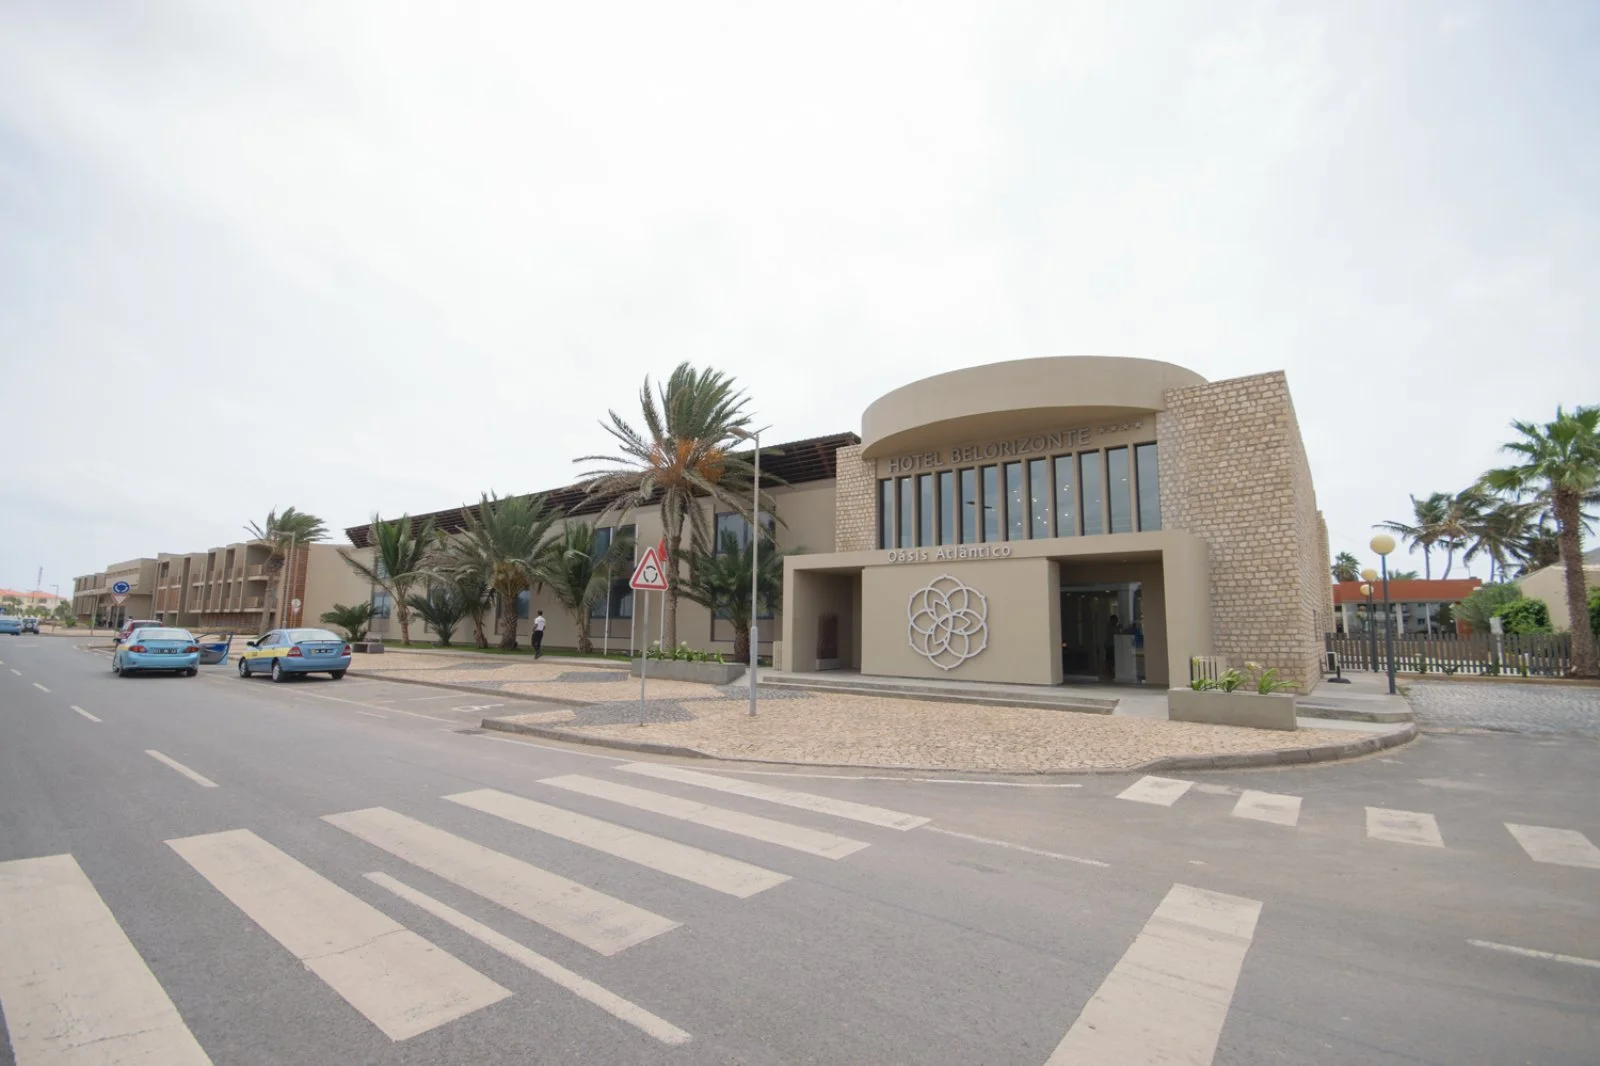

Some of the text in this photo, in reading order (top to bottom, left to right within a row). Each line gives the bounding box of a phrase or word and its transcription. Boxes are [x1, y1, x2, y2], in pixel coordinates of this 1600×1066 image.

[888, 428, 1092, 473] HOTEL BELORIZONTE
[888, 545, 1011, 562] Oásis Atlântico
